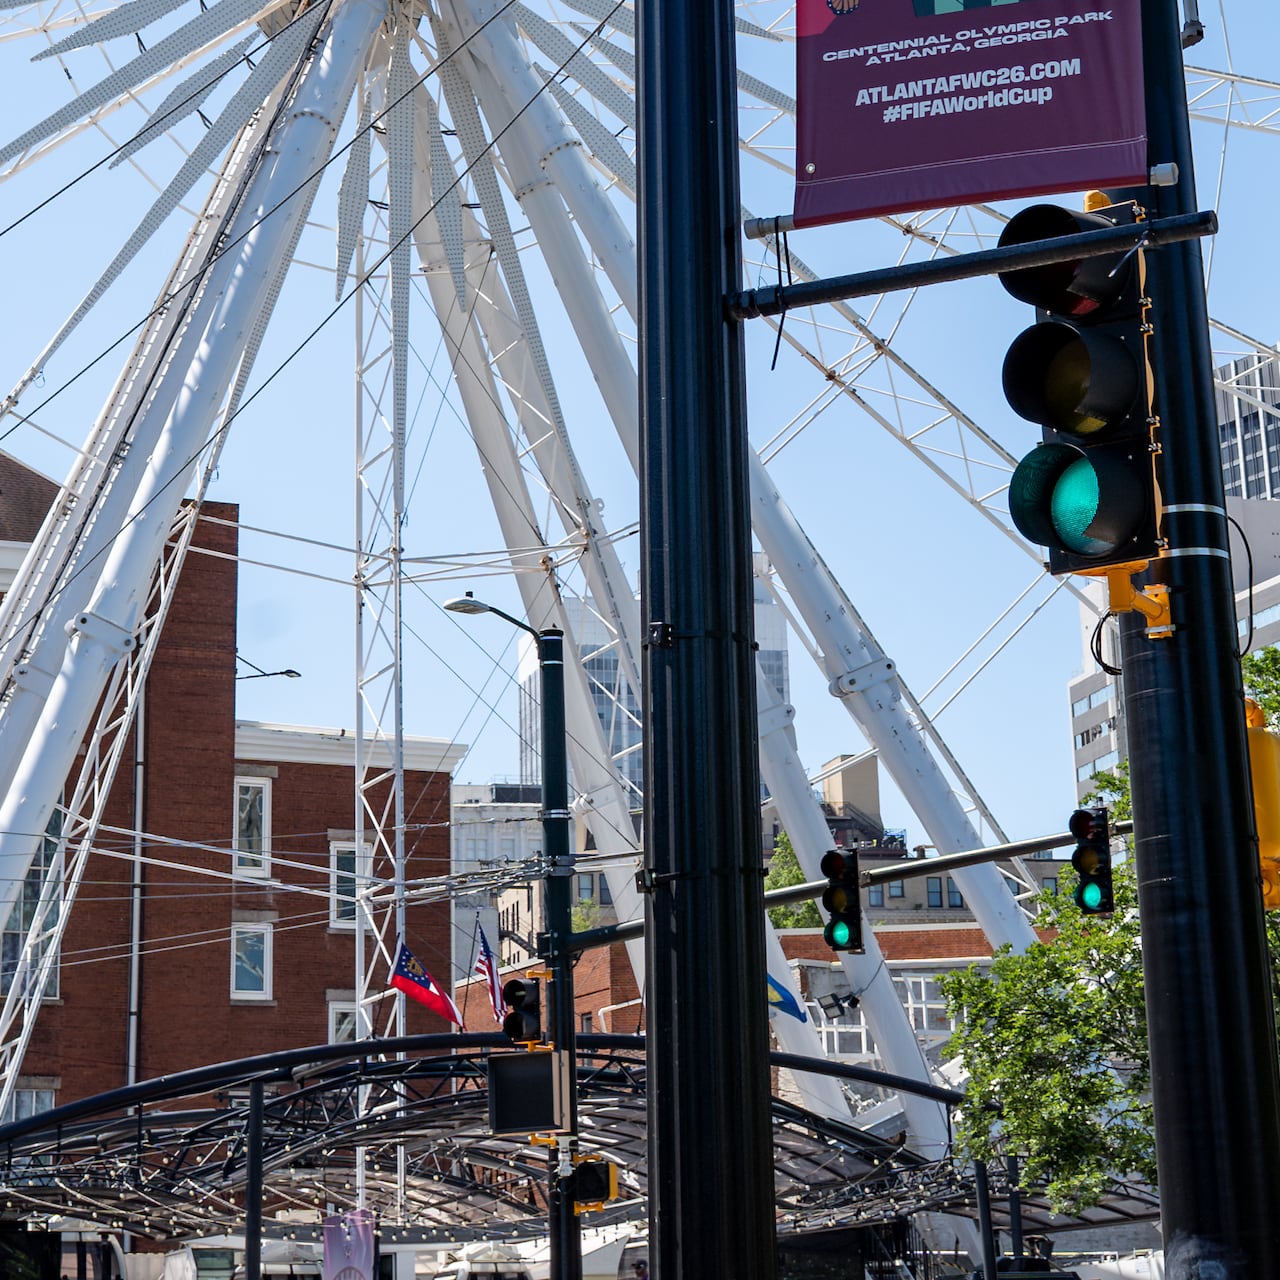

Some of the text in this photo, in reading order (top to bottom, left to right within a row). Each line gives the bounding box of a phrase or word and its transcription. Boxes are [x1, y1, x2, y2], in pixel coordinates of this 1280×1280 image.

[822, 10, 1113, 62] CENTENNIAL OLYMPIC PARK
[865, 28, 1069, 66] ATLANTA, GEORGIA
[855, 58, 1081, 107] ATLANTAFWC26.COM
[883, 84, 1053, 123] #FIFAWorldCup
